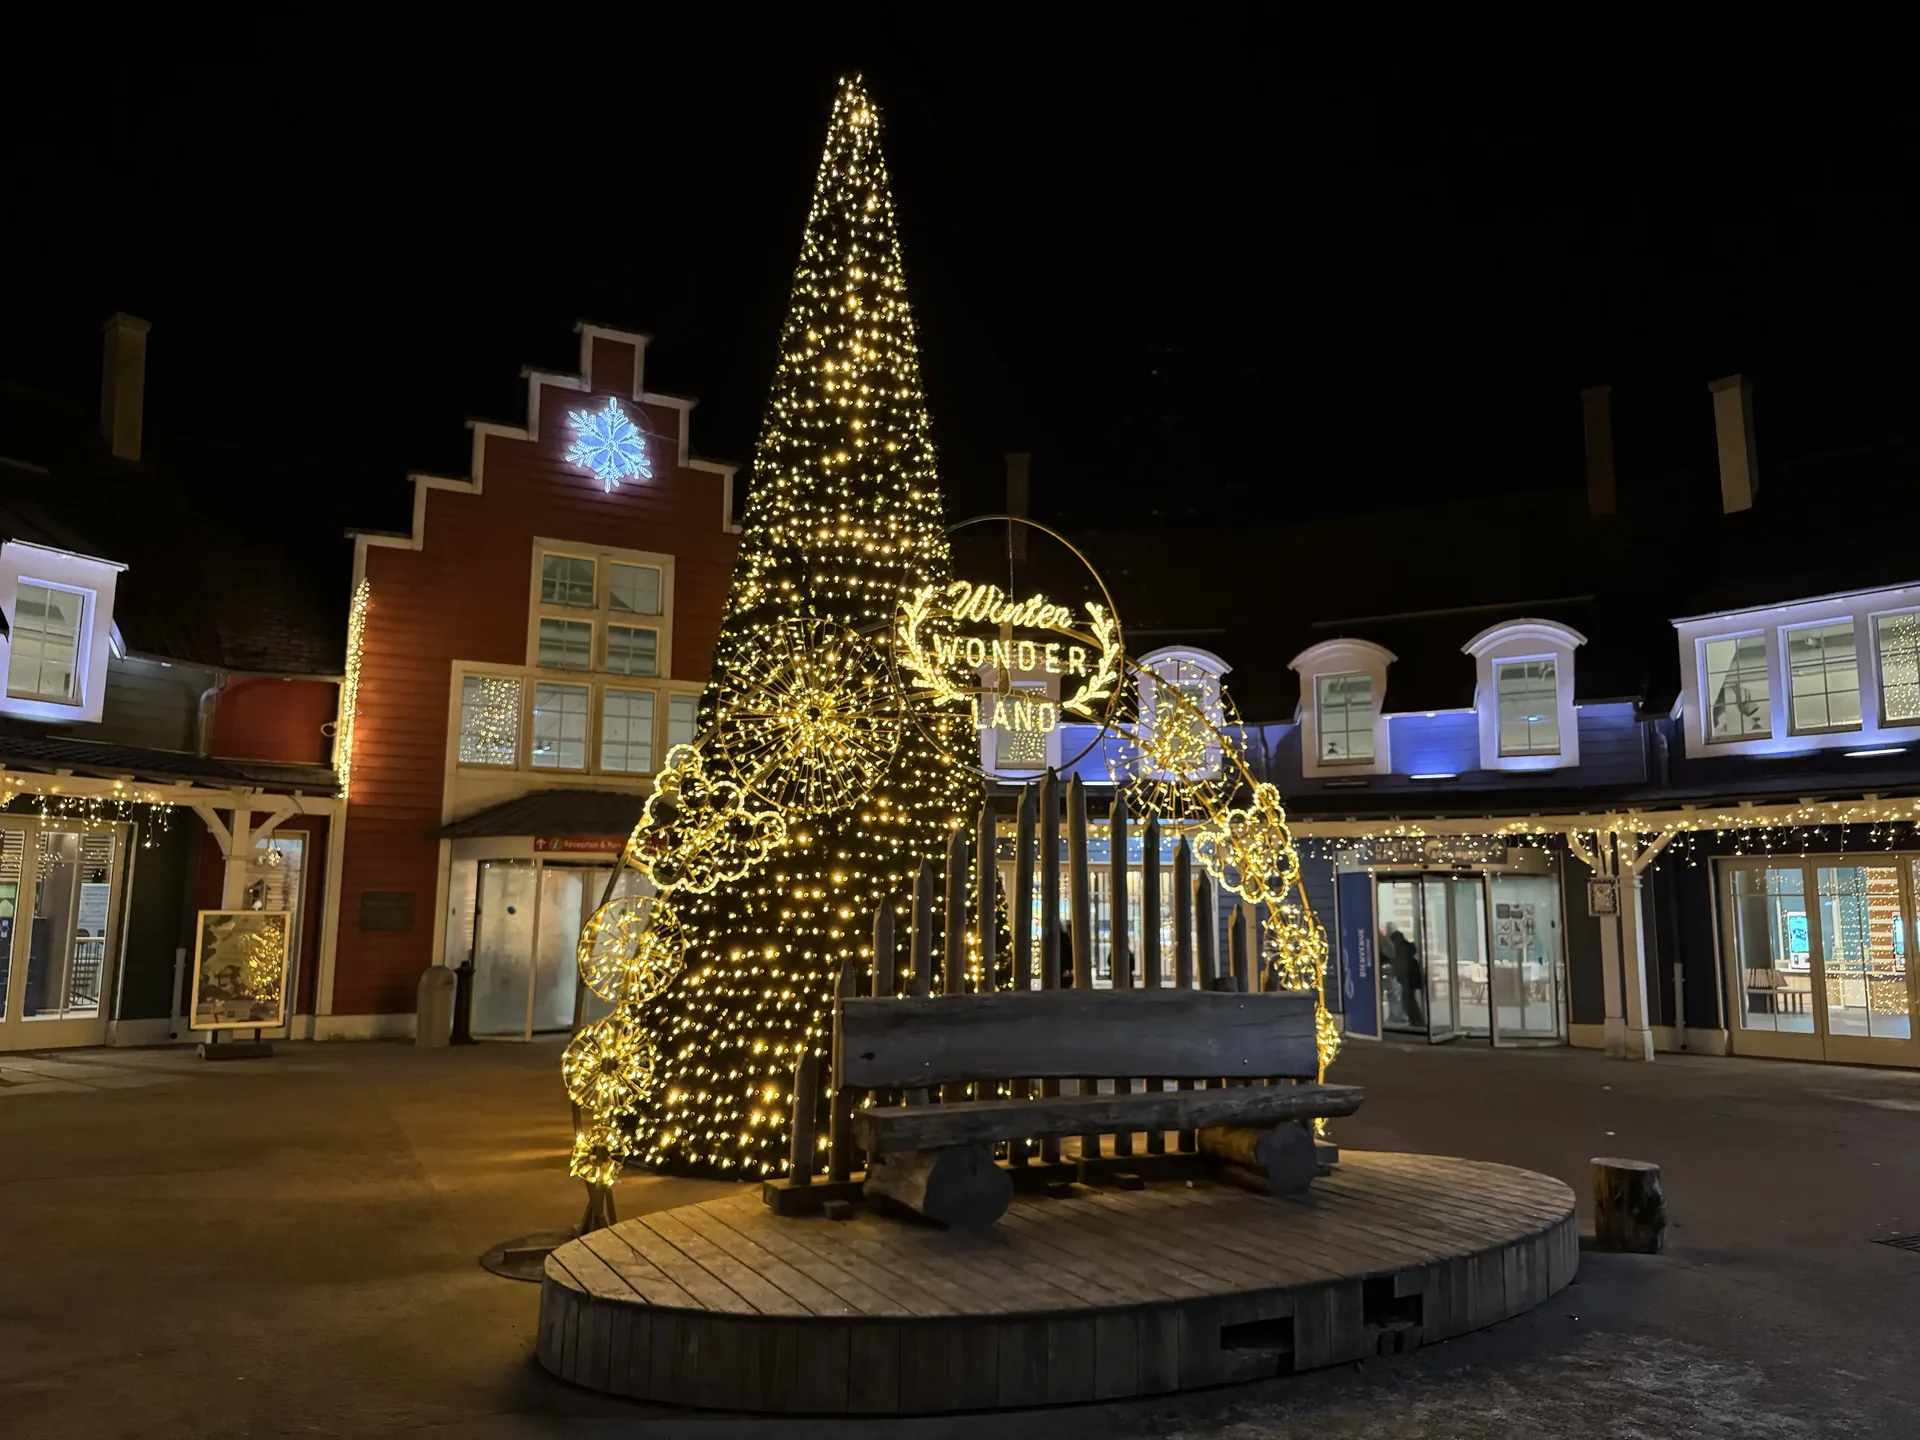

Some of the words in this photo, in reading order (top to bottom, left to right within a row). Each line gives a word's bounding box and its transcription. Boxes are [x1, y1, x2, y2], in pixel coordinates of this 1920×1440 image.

[947, 580, 1072, 628] Winter
[933, 633, 1086, 677] WONDER
[971, 697, 1056, 732] LAND
[1358, 928, 1366, 977] BIENVENUE
